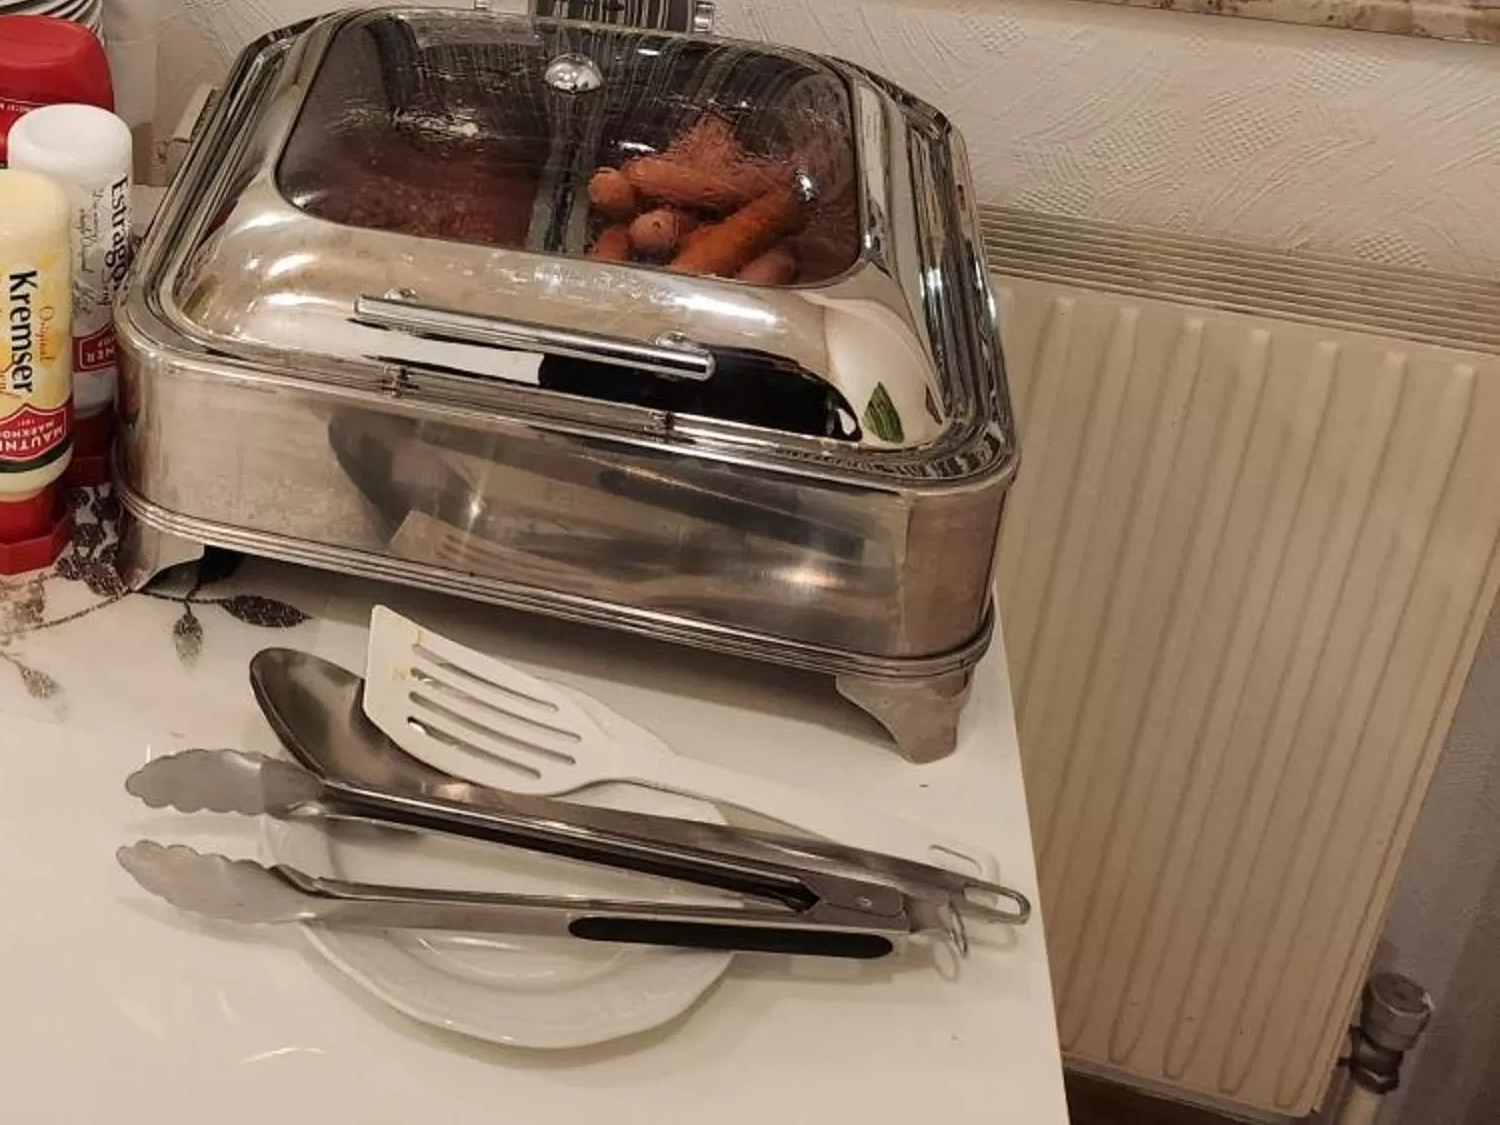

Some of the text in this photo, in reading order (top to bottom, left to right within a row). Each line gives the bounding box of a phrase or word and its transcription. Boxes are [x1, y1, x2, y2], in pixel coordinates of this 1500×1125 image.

[104, 176, 128, 293] Estrago
[9, 271, 38, 393] Kremser
[35, 306, 56, 361] Original
